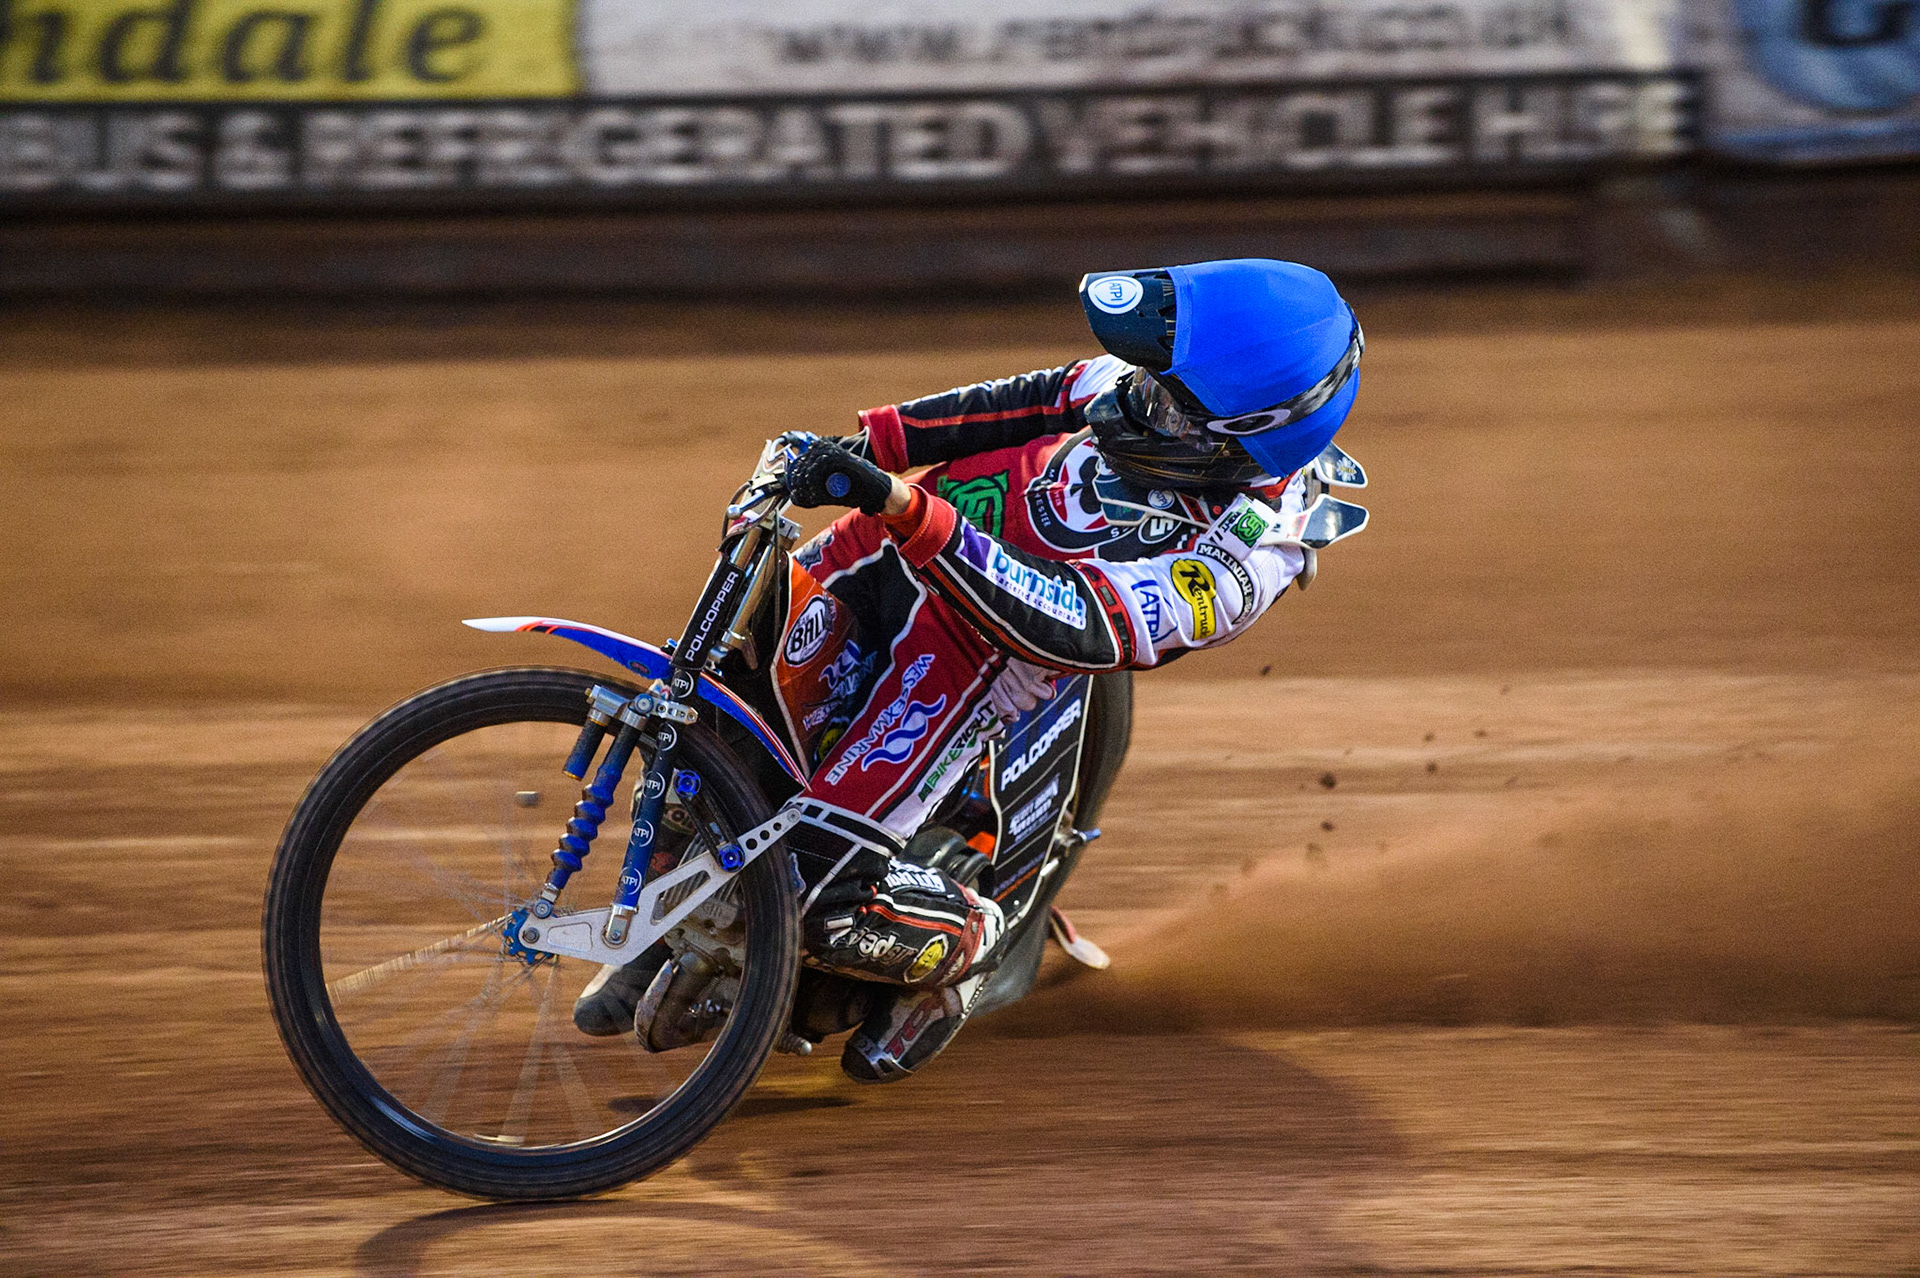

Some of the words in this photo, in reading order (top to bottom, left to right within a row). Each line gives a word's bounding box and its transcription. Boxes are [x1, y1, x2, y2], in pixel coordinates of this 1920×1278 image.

[684, 571, 740, 662] POLCOPPER
[992, 546, 1083, 617] burnside
[1000, 699, 1082, 792] POLCOPPER
